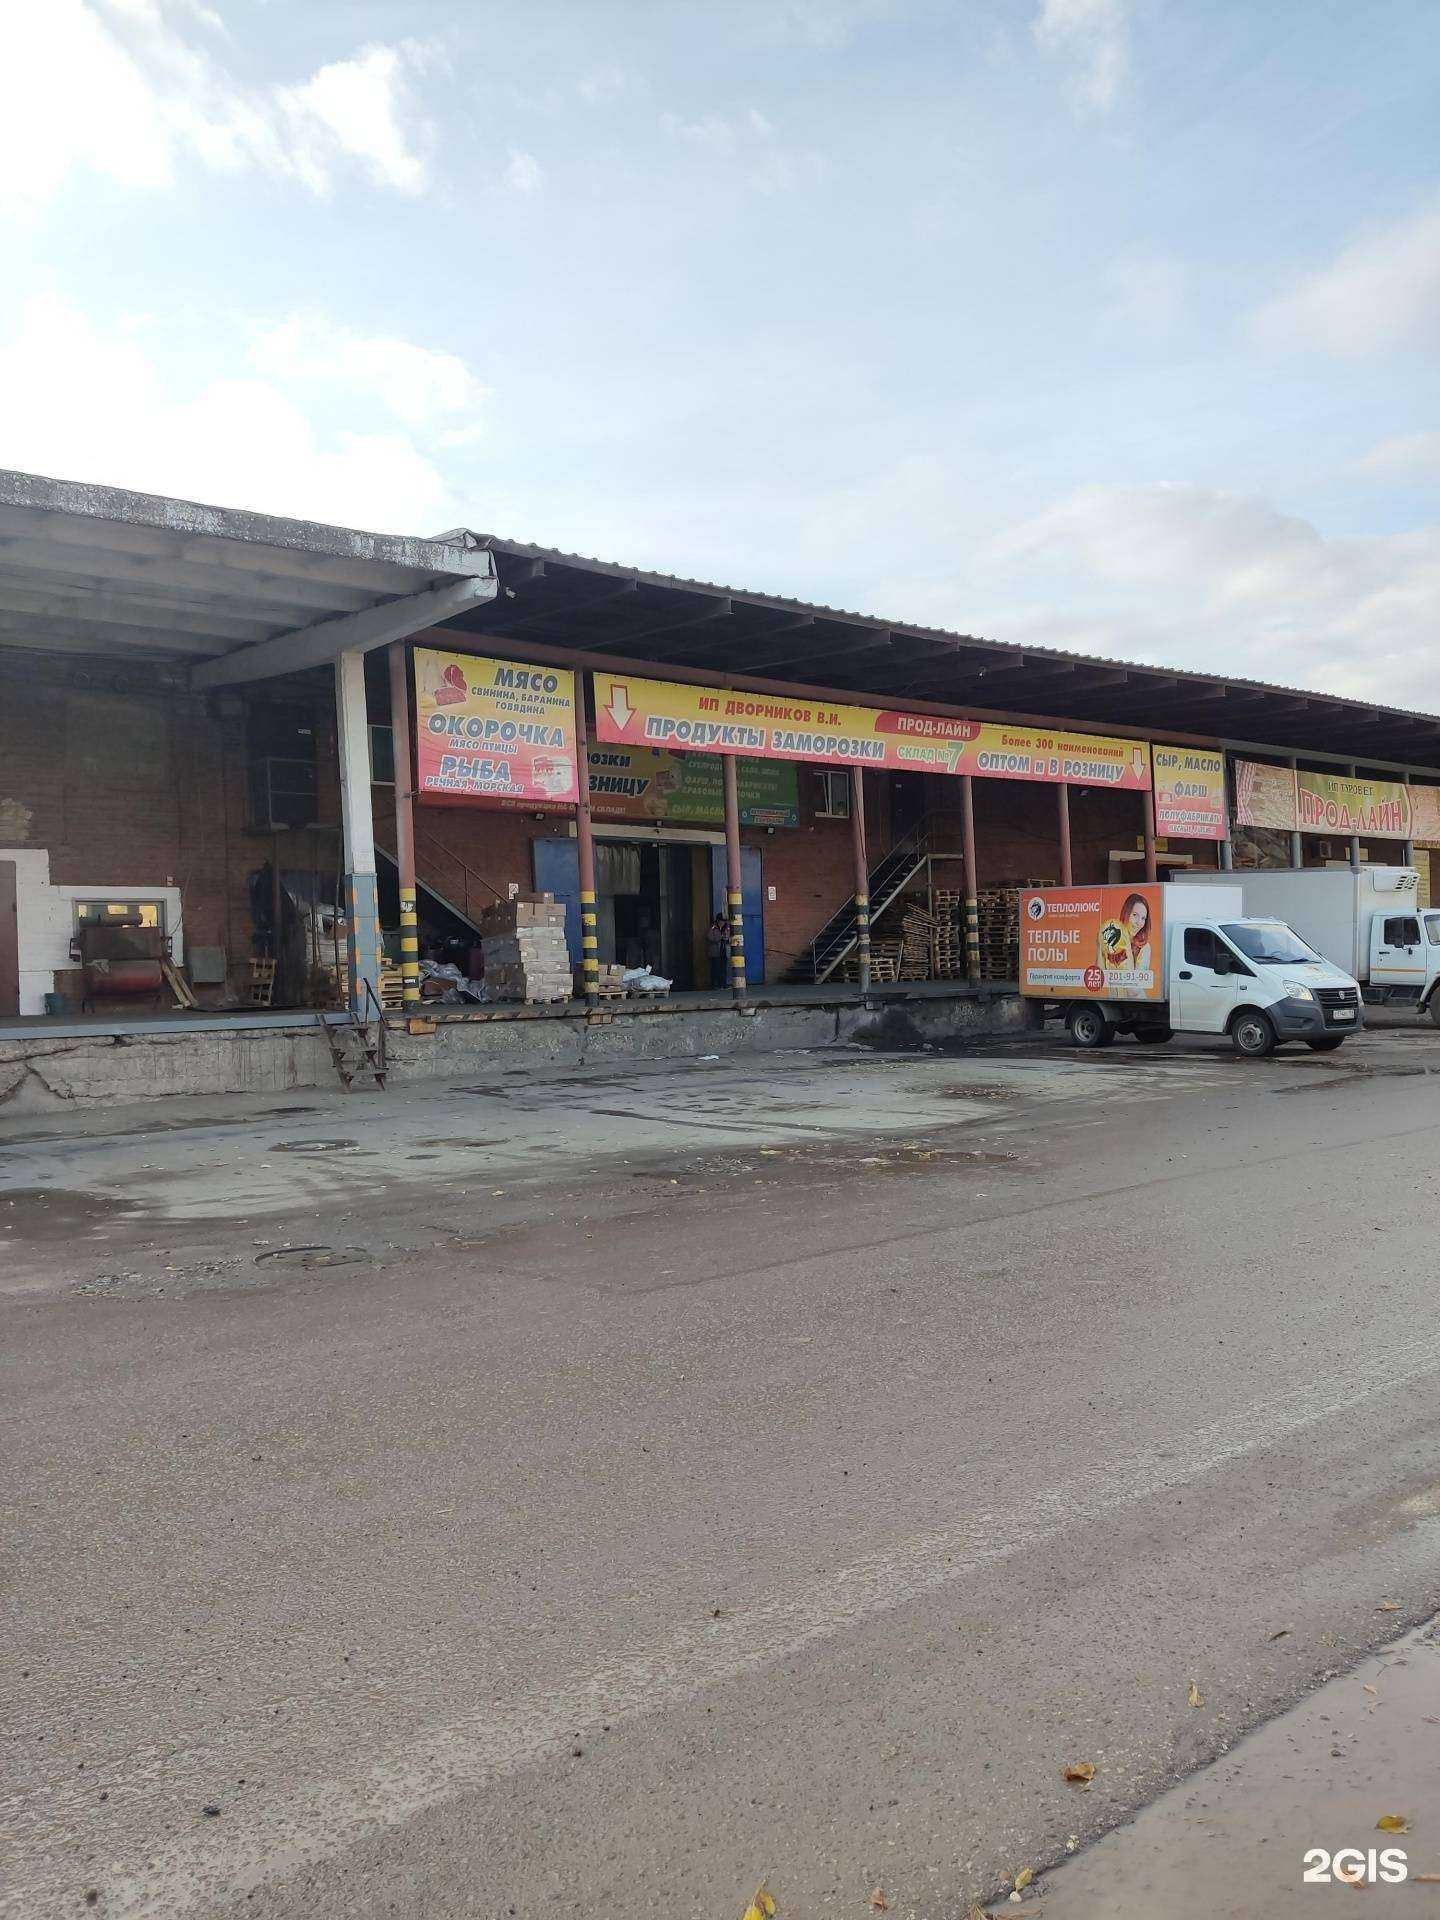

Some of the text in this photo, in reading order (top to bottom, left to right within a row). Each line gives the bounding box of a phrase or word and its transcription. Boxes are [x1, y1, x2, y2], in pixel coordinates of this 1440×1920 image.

[494, 668, 558, 693] МЯСО
[471, 686, 570, 707] СВИНИНА, БАРАНИНА
[495, 701, 545, 715] ГОВЯДИНА
[698, 696, 719, 711] ИП
[724, 700, 811, 722] ДВОРНИКОВ
[428, 713, 565, 748] ОКОРОЧКА
[897, 717, 971, 738] ПРОД-ЛАЙН
[449, 738, 517, 755] МЯСО ПТИЦЫ
[645, 715, 766, 749] ПРОДУКТЫ
[771, 729, 886, 760] ЗАМОРОЗКИ
[1001, 735, 1124, 757] Более 300 наименований
[588, 751, 630, 767] ОЗКИ
[897, 745, 935, 763] СКЛАД
[441, 755, 511, 782] РЫБА
[977, 752, 1030, 773] ОПТОМ
[1048, 758, 1058, 774] В
[1063, 760, 1124, 783] РОЗНИЦУ
[1184, 756, 1221, 773] МАСЛО
[426, 777, 525, 794] РЕЧНАЯ, МОРСКАЯ
[1174, 781, 1208, 798] ФАРШ
[1300, 787, 1403, 832] ПРОД-ЛАЙН
[1046, 902, 1100, 913] ТЕПЛОЛЮКС
[1027, 930, 1080, 944] ТЕПЛЫЕ
[1028, 948, 1068, 962] ПОЛЫ
[1088, 969, 1101, 981] 25
